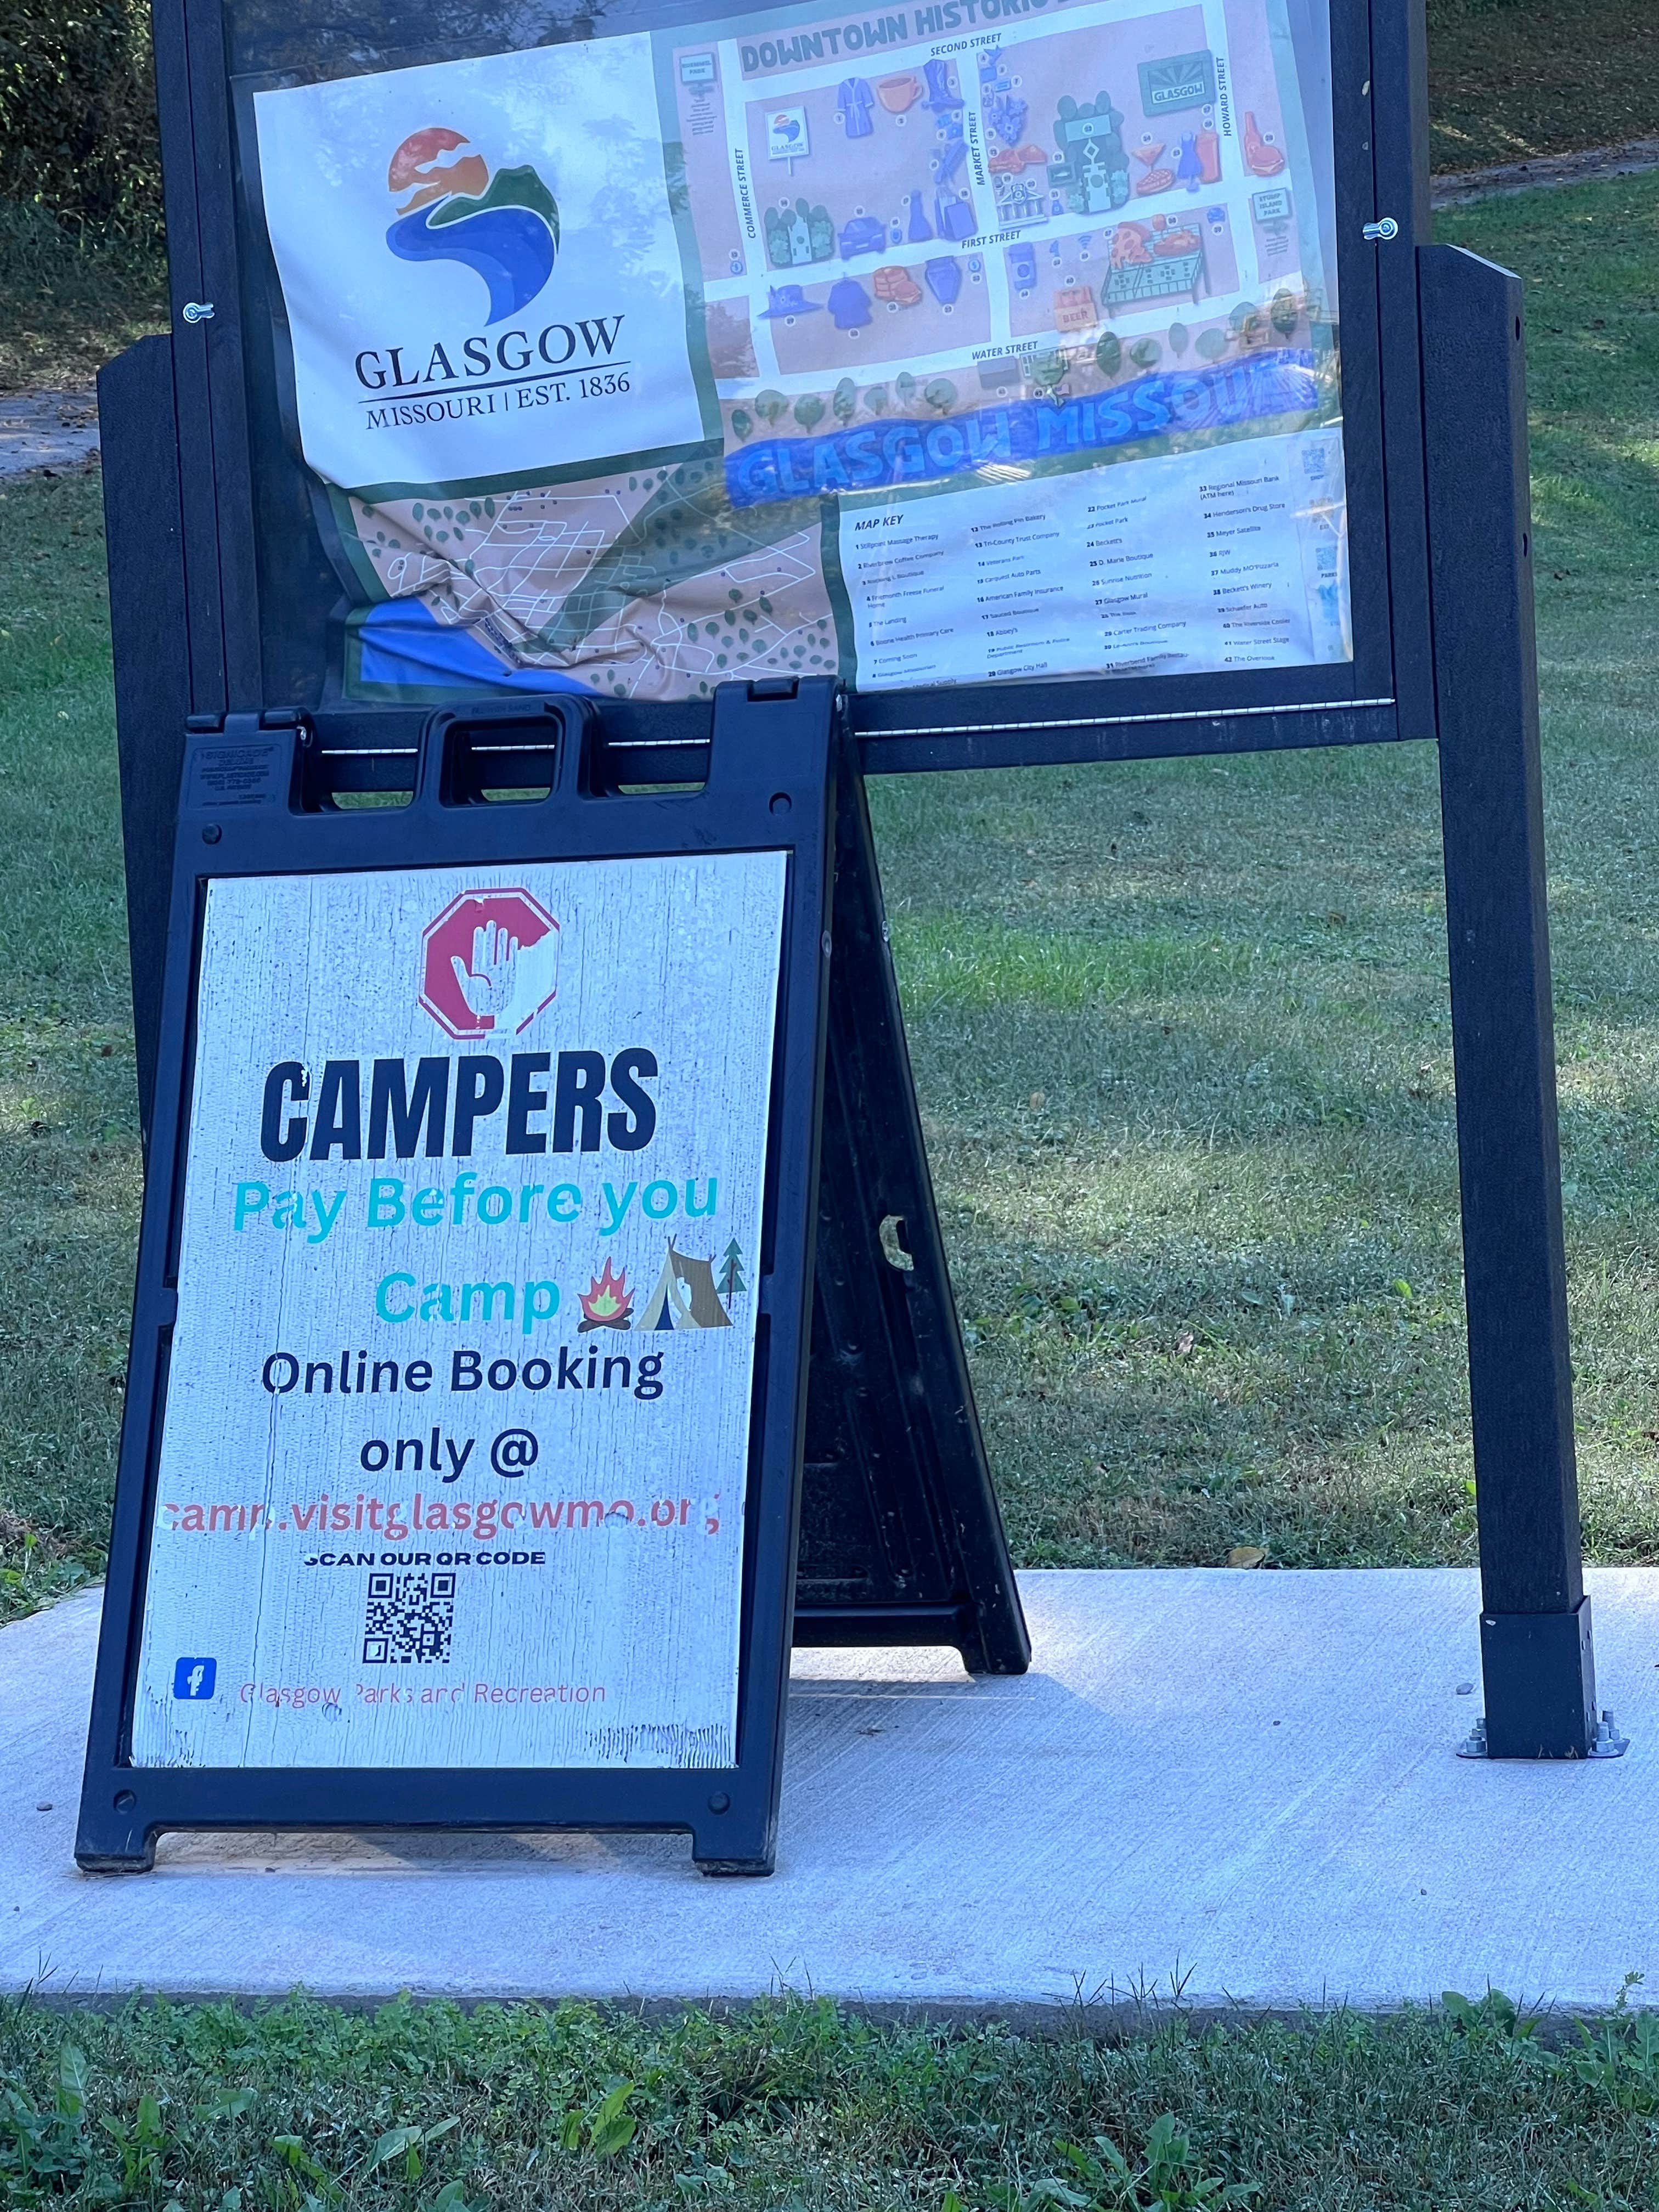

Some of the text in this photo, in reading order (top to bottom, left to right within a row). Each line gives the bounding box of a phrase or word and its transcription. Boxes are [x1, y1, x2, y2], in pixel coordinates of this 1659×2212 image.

[741, 13, 908, 72] DOWNTOWN
[931, 33, 1001, 56] SECOND STREET
[1154, 83, 1203, 101] GLASGOW
[1216, 57, 1232, 136] HOWARD STREET
[968, 111, 985, 185] MARKET STREET
[735, 148, 757, 239] COMMERCE STREET
[962, 230, 1021, 249] FIRST STREET
[1063, 311, 1088, 323] BEER
[354, 314, 625, 390] GLASGOW
[972, 341, 1038, 360] WATER STREET
[365, 371, 631, 430] MISSOURI EST. 1836
[738, 362, 1289, 495] GLASGOW MISSOU
[1209, 482, 1234, 490] Regional
[855, 515, 904, 531] MAP KEY
[1213, 507, 1251, 517] Henderson's
[984, 538, 1015, 546] Tri-County
[997, 667, 1022, 676] Glasgow
[261, 1048, 659, 1163] CAMPERS
[234, 1172, 718, 1244] Pay Before you
[375, 1272, 561, 1334] Camp
[262, 1345, 664, 1400] Online Booking
[360, 1427, 538, 1483] only @
[165, 1493, 719, 1541] am.visitglasgowmo.or
[380, 1552, 431, 1566] OUR
[436, 1552, 471, 1566] QR
[476, 1551, 546, 1565] CODE
[240, 1683, 341, 1708] Glasgow
[475, 1683, 606, 1703] Recreation
